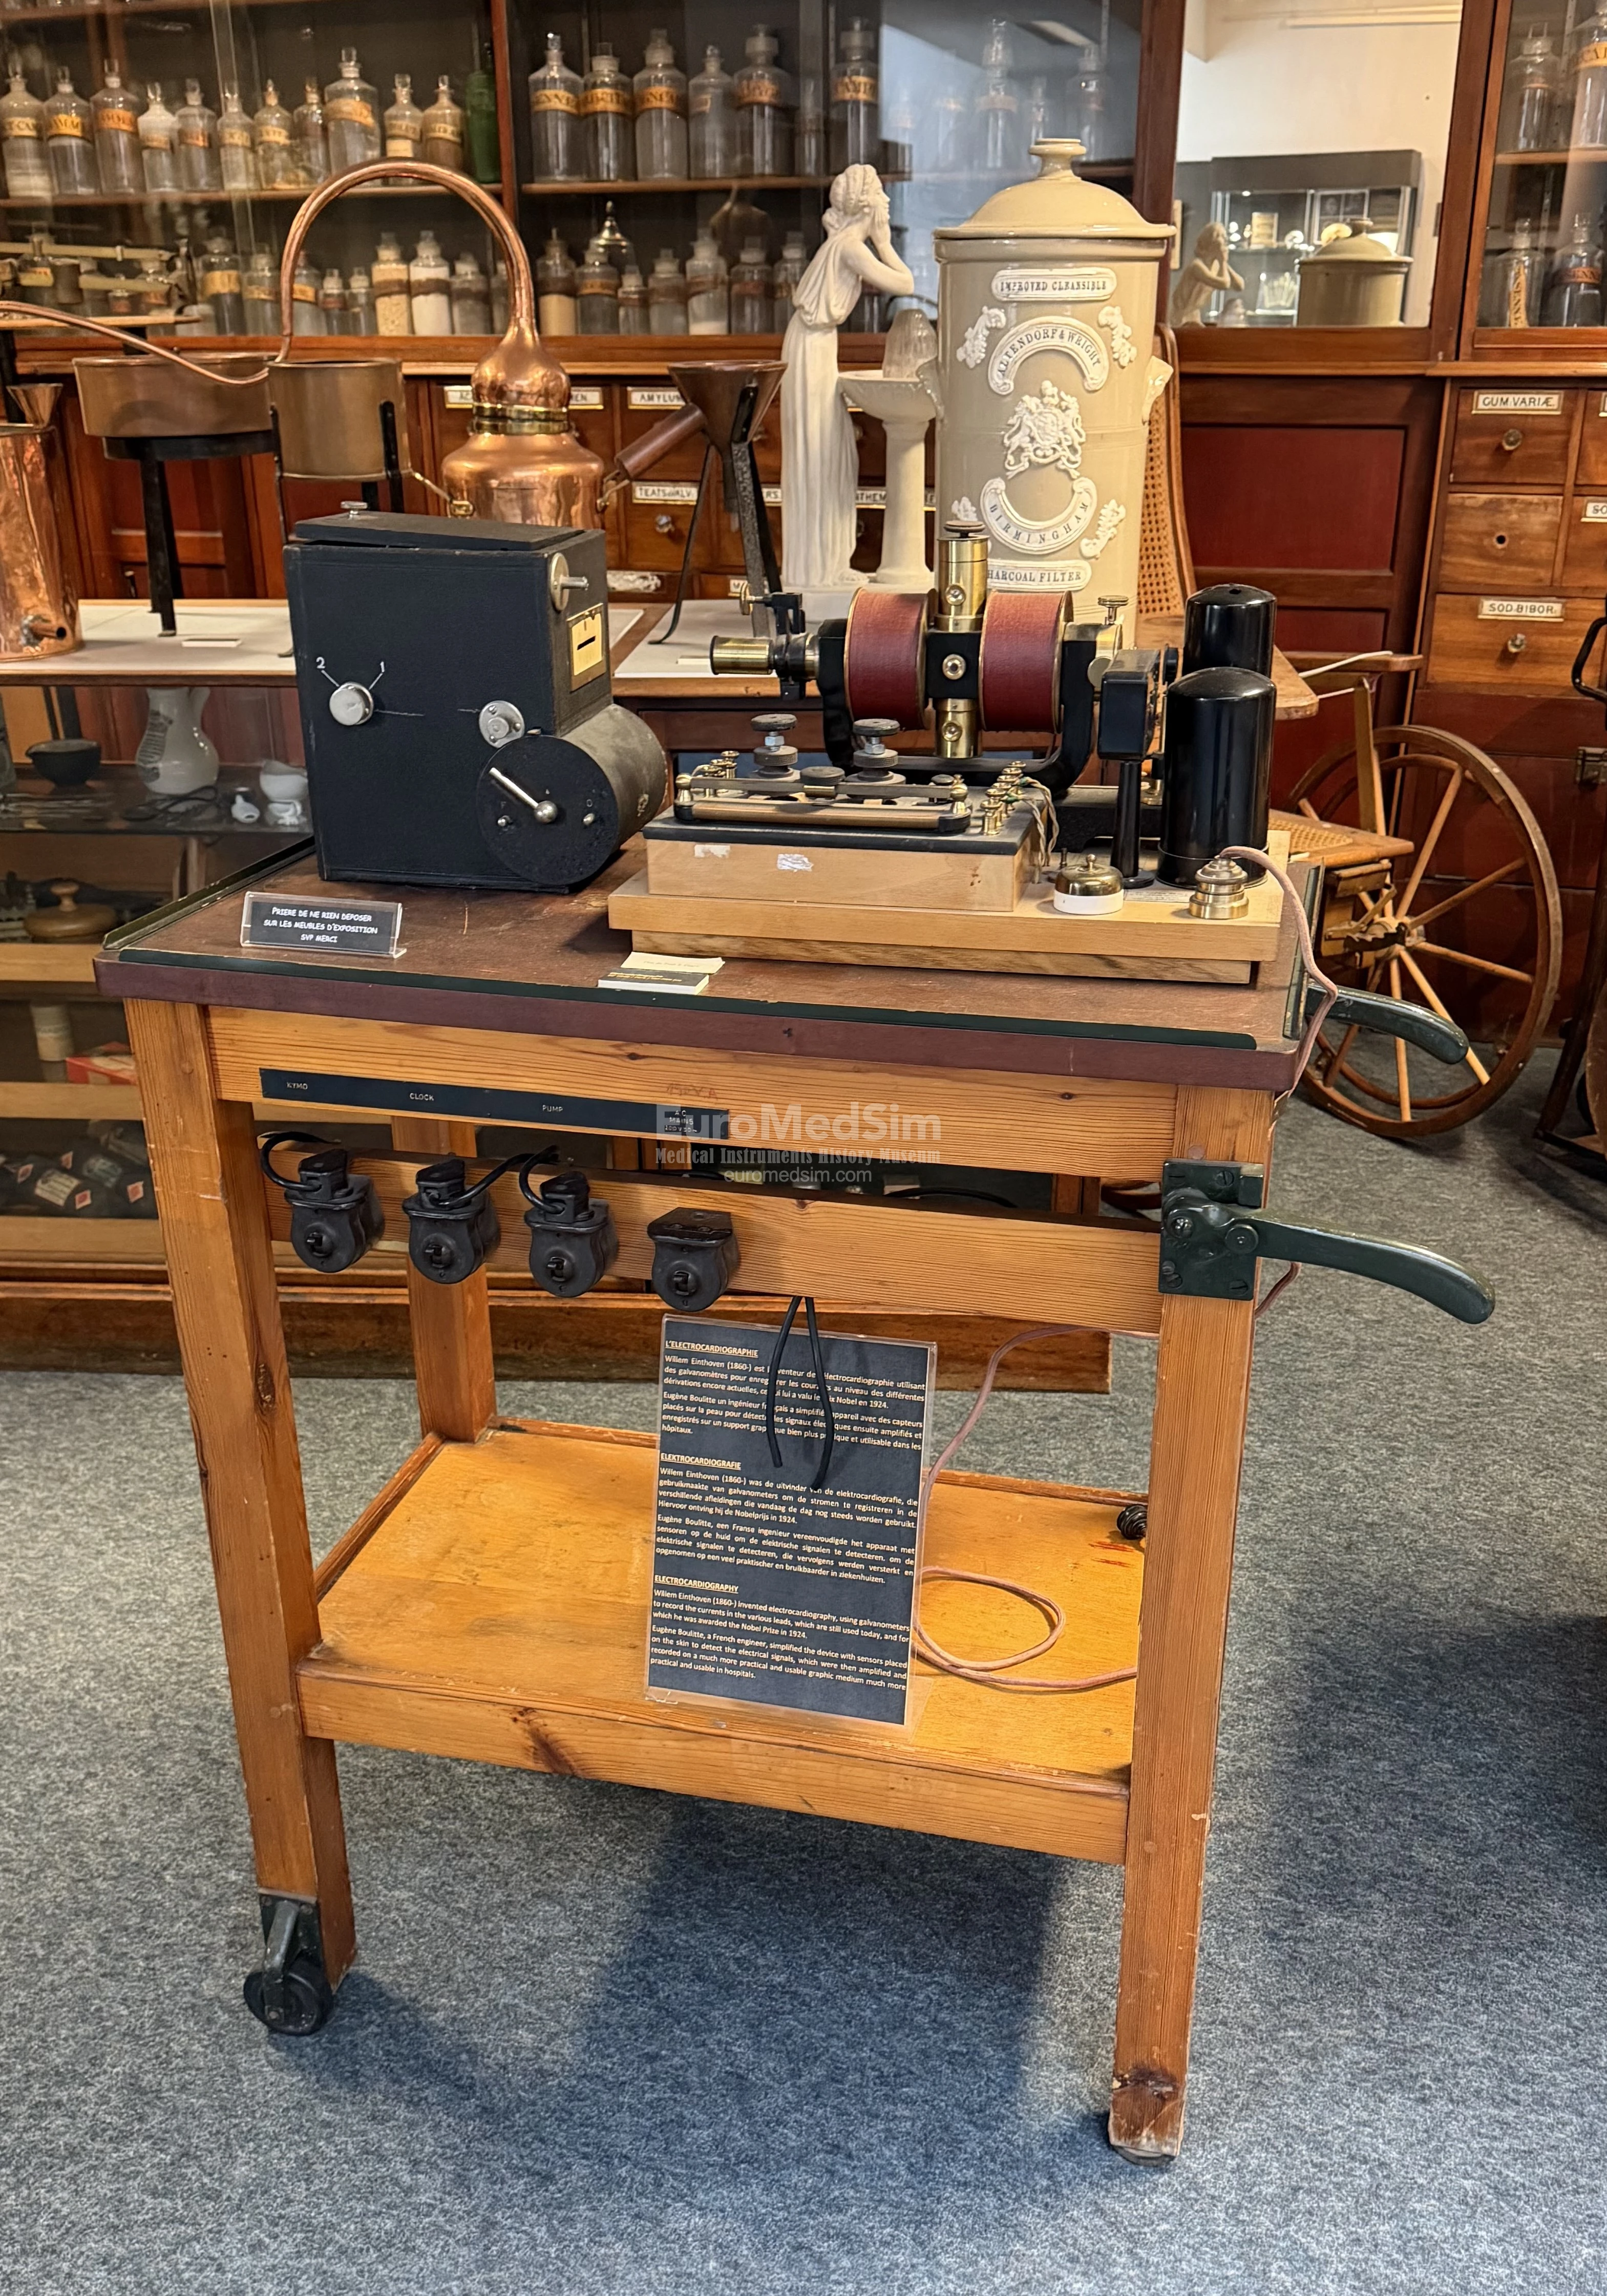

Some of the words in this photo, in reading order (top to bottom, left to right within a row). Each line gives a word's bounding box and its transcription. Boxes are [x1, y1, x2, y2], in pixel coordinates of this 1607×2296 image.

[1001, 281, 1048, 291] IMPROVED
[1051, 281, 1107, 291] CLEANSIBLE
[1067, 331, 1101, 367] WRIGHT
[989, 502, 1088, 544] BIRMINGHAM
[1039, 572, 1082, 582] FILTER
[315, 657, 326, 669] 2
[379, 661, 385, 672] 1
[298, 910, 308, 918] DE
[321, 912, 340, 920] RIEN
[263, 919, 278, 928] SUR
[294, 922, 325, 931] MEUBLES
[326, 923, 378, 934] D'EXPOSITION
[409, 1092, 435, 1101] CLOCK
[665, 1340, 759, 1357] L'ELECTROCARDIOGRAPHIE
[662, 1424, 693, 1434] hôpitaux.
[660, 1453, 742, 1470] ELEKTROCARDIOGRAFIE
[660, 1468, 683, 1477] Willem
[686, 1470, 720, 1481] Einthoven
[722, 1475, 746, 1485] (1860-)
[776, 1482, 807, 1492] uitvinder
[836, 1490, 904, 1505] elektrocardiografie,
[660, 1479, 709, 1490] gebruikmaakte
[728, 1487, 778, 1500] galvanometers
[811, 1498, 839, 1507] stromen
[855, 1504, 893, 1514] registreren
[897, 1508, 904, 1516] in
[659, 1491, 703, 1501] verschillende
[705, 1495, 742, 1506] afleidingen
[757, 1503, 786, 1513] vandaag
[800, 1507, 813, 1516] dag
[831, 1512, 853, 1520] steeds
[856, 1515, 882, 1524] worden
[885, 1519, 916, 1528] gebruikt.
[654, 1575, 739, 1593] ELECTROCARDIOGRAPHY
[654, 1589, 677, 1598] Willem
[678, 1592, 711, 1603] Einthoven
[713, 1597, 737, 1608] (1860-)
[738, 1600, 768, 1611] invented
[768, 1605, 838, 1622] electrocardiography,
[839, 1616, 858, 1625] using
[859, 1618, 910, 1631] galvanometers
[653, 1611, 672, 1619] which
[697, 1618, 727, 1627] awarded
[742, 1623, 762, 1632] Nobel
[763, 1626, 779, 1634] Prize
[789, 1630, 808, 1639] 1924.
[697, 1608, 726, 1616] currents
[747, 1614, 772, 1623] various
[773, 1616, 793, 1627] leads,
[794, 1620, 815, 1628] which
[861, 1630, 882, 1639] today,
[652, 1625, 676, 1634] Eugène
[678, 1628, 706, 1639] Boulitte,
[713, 1633, 735, 1642] French
[736, 1638, 768, 1649] engineer,
[770, 1642, 802, 1653] simplified
[804, 1647, 815, 1655] the
[817, 1649, 839, 1658] device
[857, 1656, 883, 1665] sensors
[884, 1659, 907, 1668] placed
[650, 1658, 678, 1667] practical
[724, 1667, 756, 1678] hospitals.
[651, 1648, 681, 1656] recorded
[739, 1660, 768, 1669] practical
[808, 1671, 834, 1679] graphic
[835, 1675, 864, 1683] medium
[701, 1643, 723, 1652] detect
[738, 1648, 769, 1658] electrical
[771, 1653, 795, 1663] signals,
[798, 1657, 818, 1666] which
[840, 1663, 856, 1672] then
[858, 1667, 891, 1677] amplified
